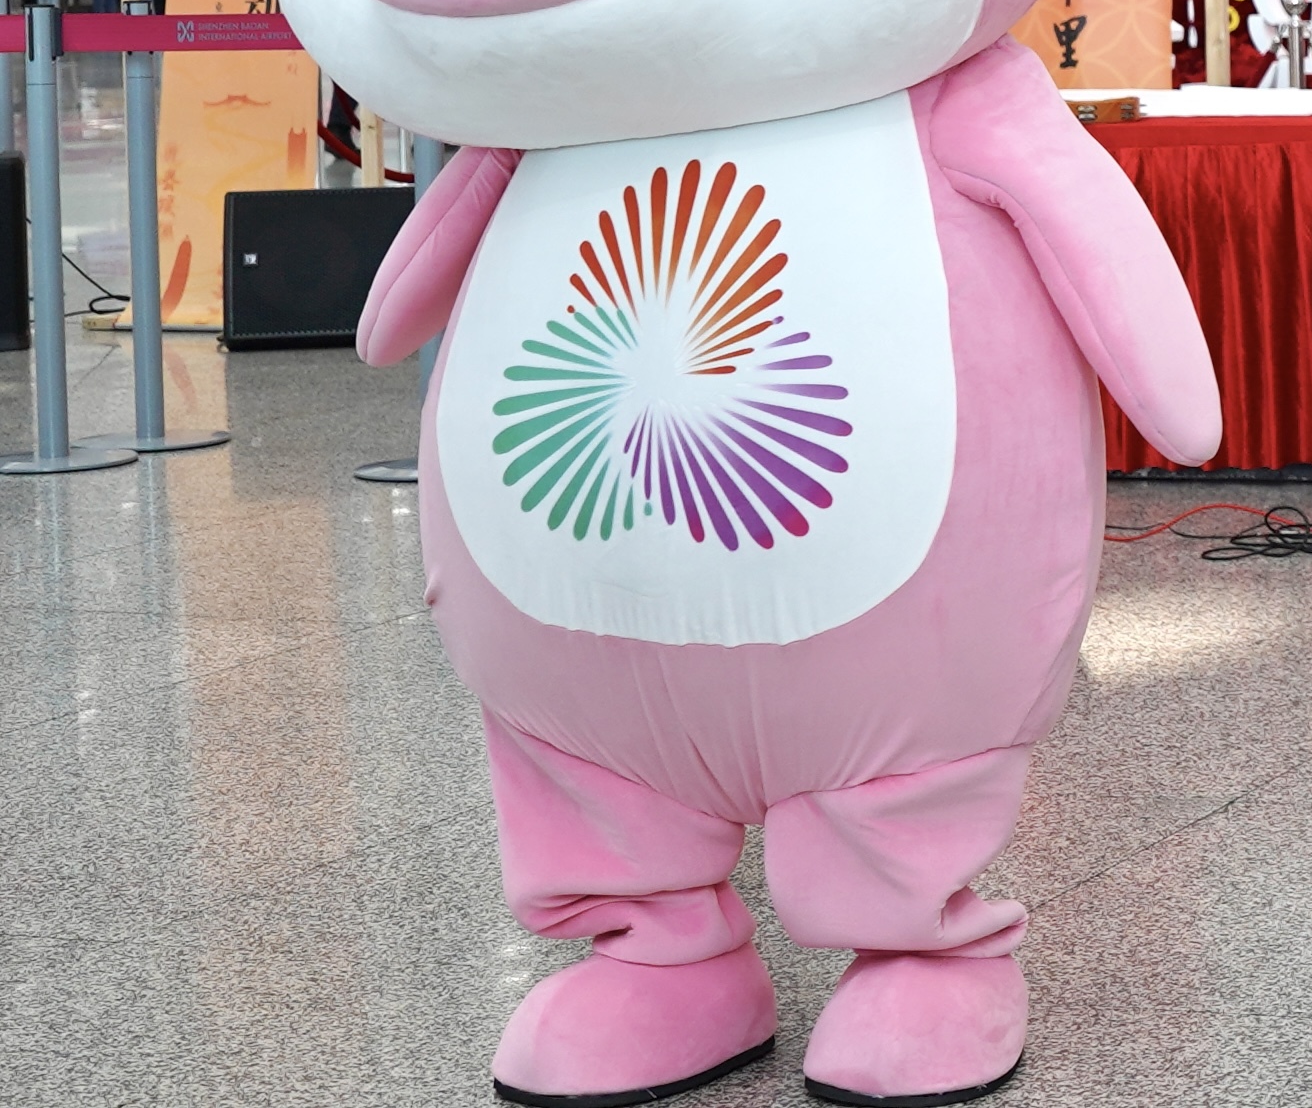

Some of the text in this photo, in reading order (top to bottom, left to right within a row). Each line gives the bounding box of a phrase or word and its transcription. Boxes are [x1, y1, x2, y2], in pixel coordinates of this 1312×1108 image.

[198, 22, 238, 31] SHENZHEN
[198, 31, 292, 41] INTERNATIONAL AIRPORT
